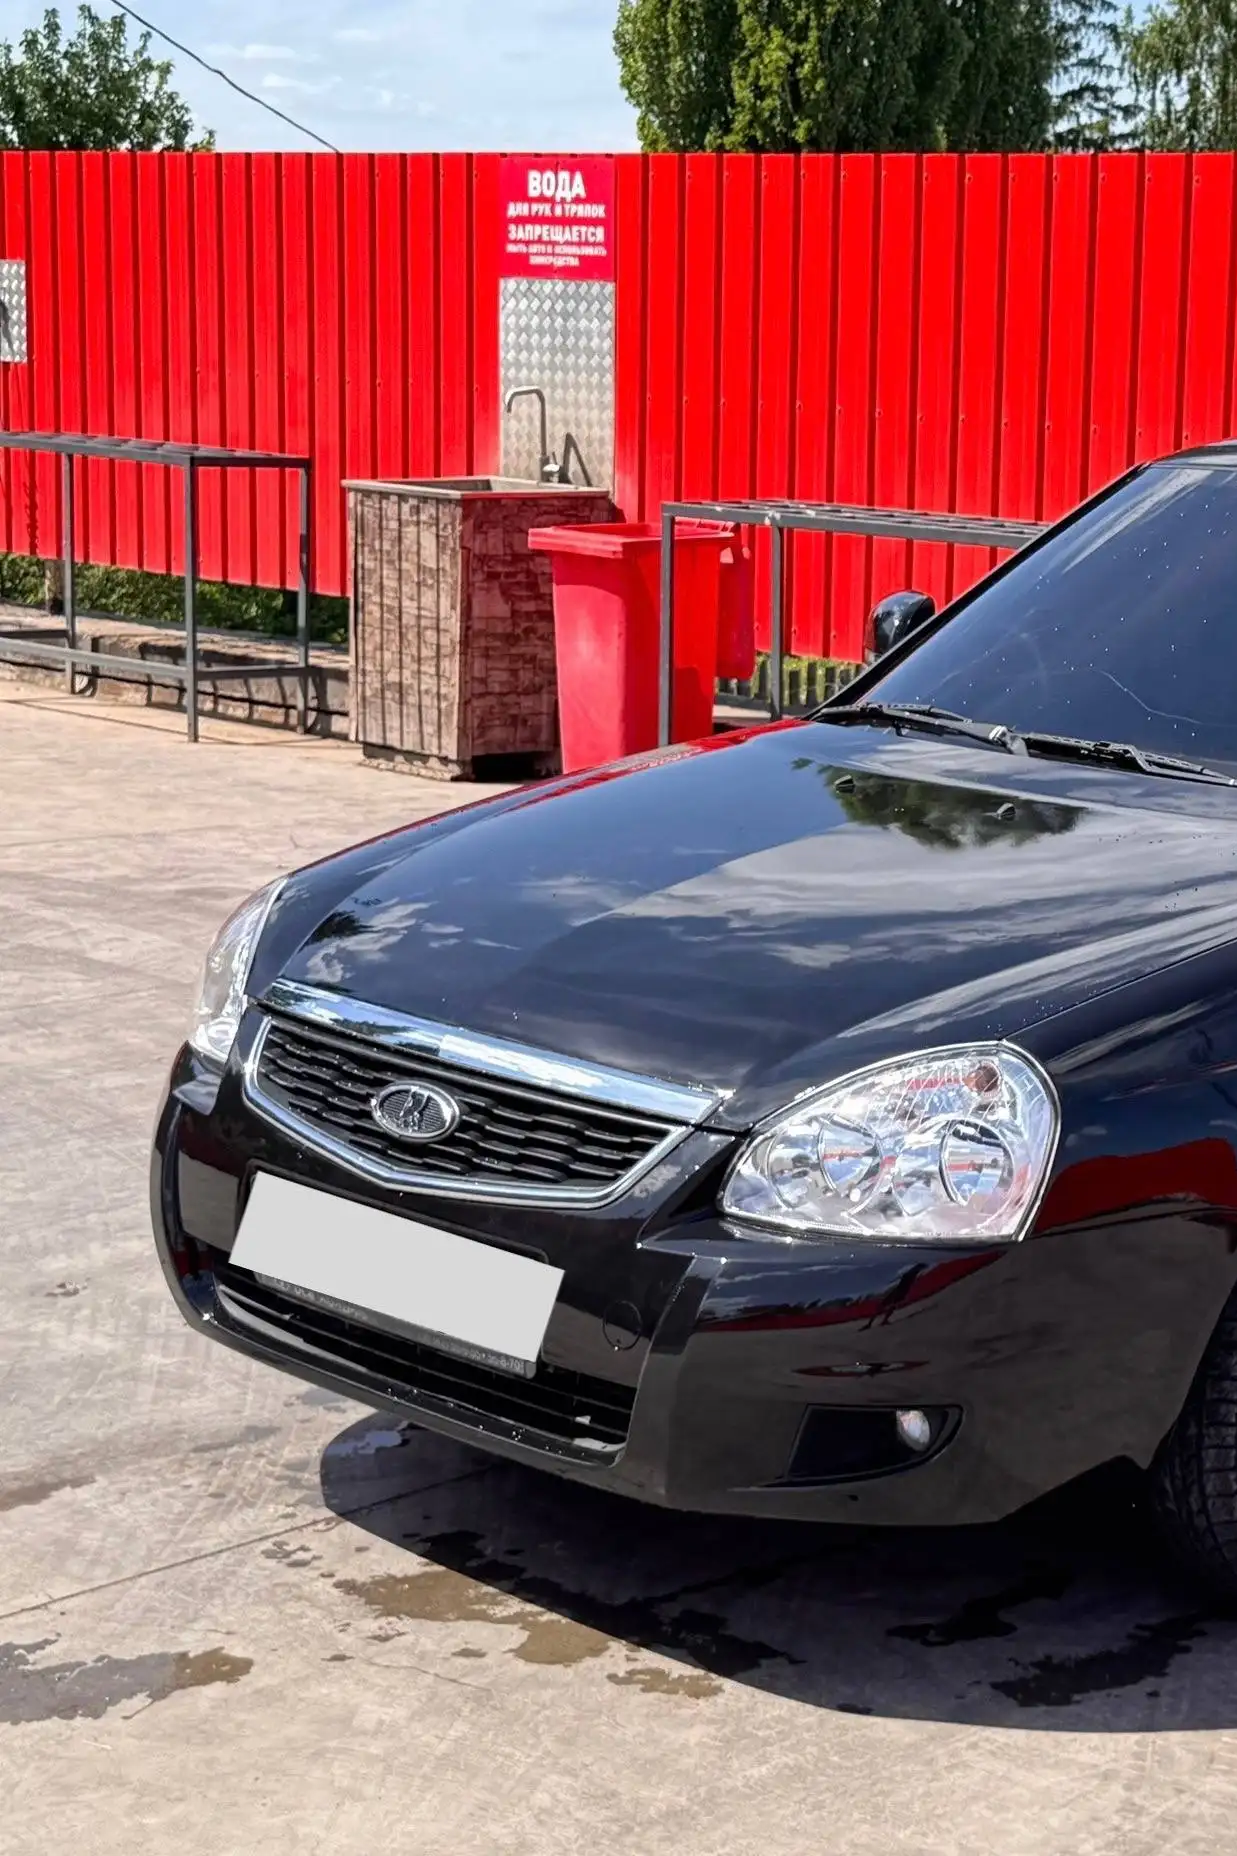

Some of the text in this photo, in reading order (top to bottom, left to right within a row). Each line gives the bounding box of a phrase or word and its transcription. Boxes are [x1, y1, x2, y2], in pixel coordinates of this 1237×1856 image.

[527, 169, 587, 202] ВОДА
[507, 202, 606, 218] ДЛЯ РУК И ТРЯПОК
[507, 223, 605, 243] ЗАПРЕЩАЕТСЯ
